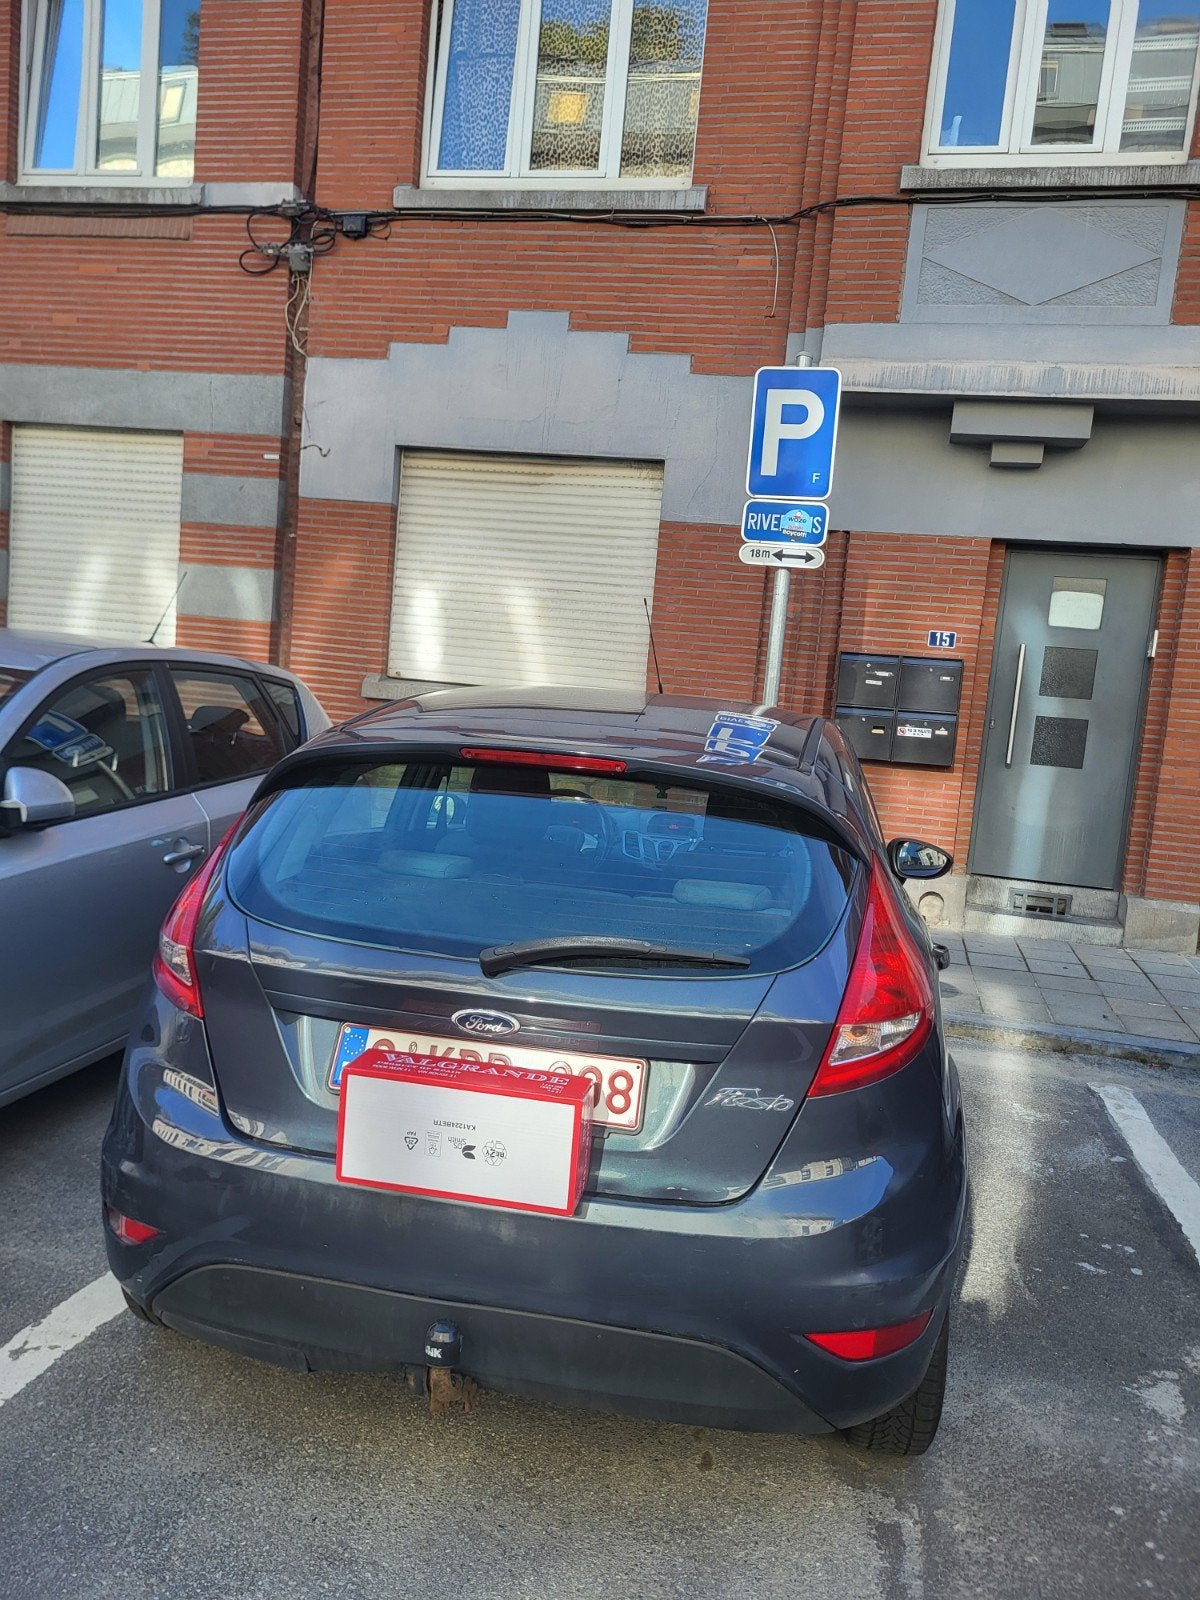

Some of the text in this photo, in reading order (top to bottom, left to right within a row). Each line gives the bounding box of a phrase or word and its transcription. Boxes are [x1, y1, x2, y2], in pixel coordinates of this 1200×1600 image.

[760, 388, 825, 476] P
[812, 472, 821, 483] F
[747, 512, 822, 534] RIVES
[935, 632, 950, 647] 15
[465, 1014, 504, 1033] Ford
[383, 1052, 570, 1086] VALGRANDE
[704, 1087, 794, 1111] Fiesta
[448, 1136, 467, 1145] Smith
